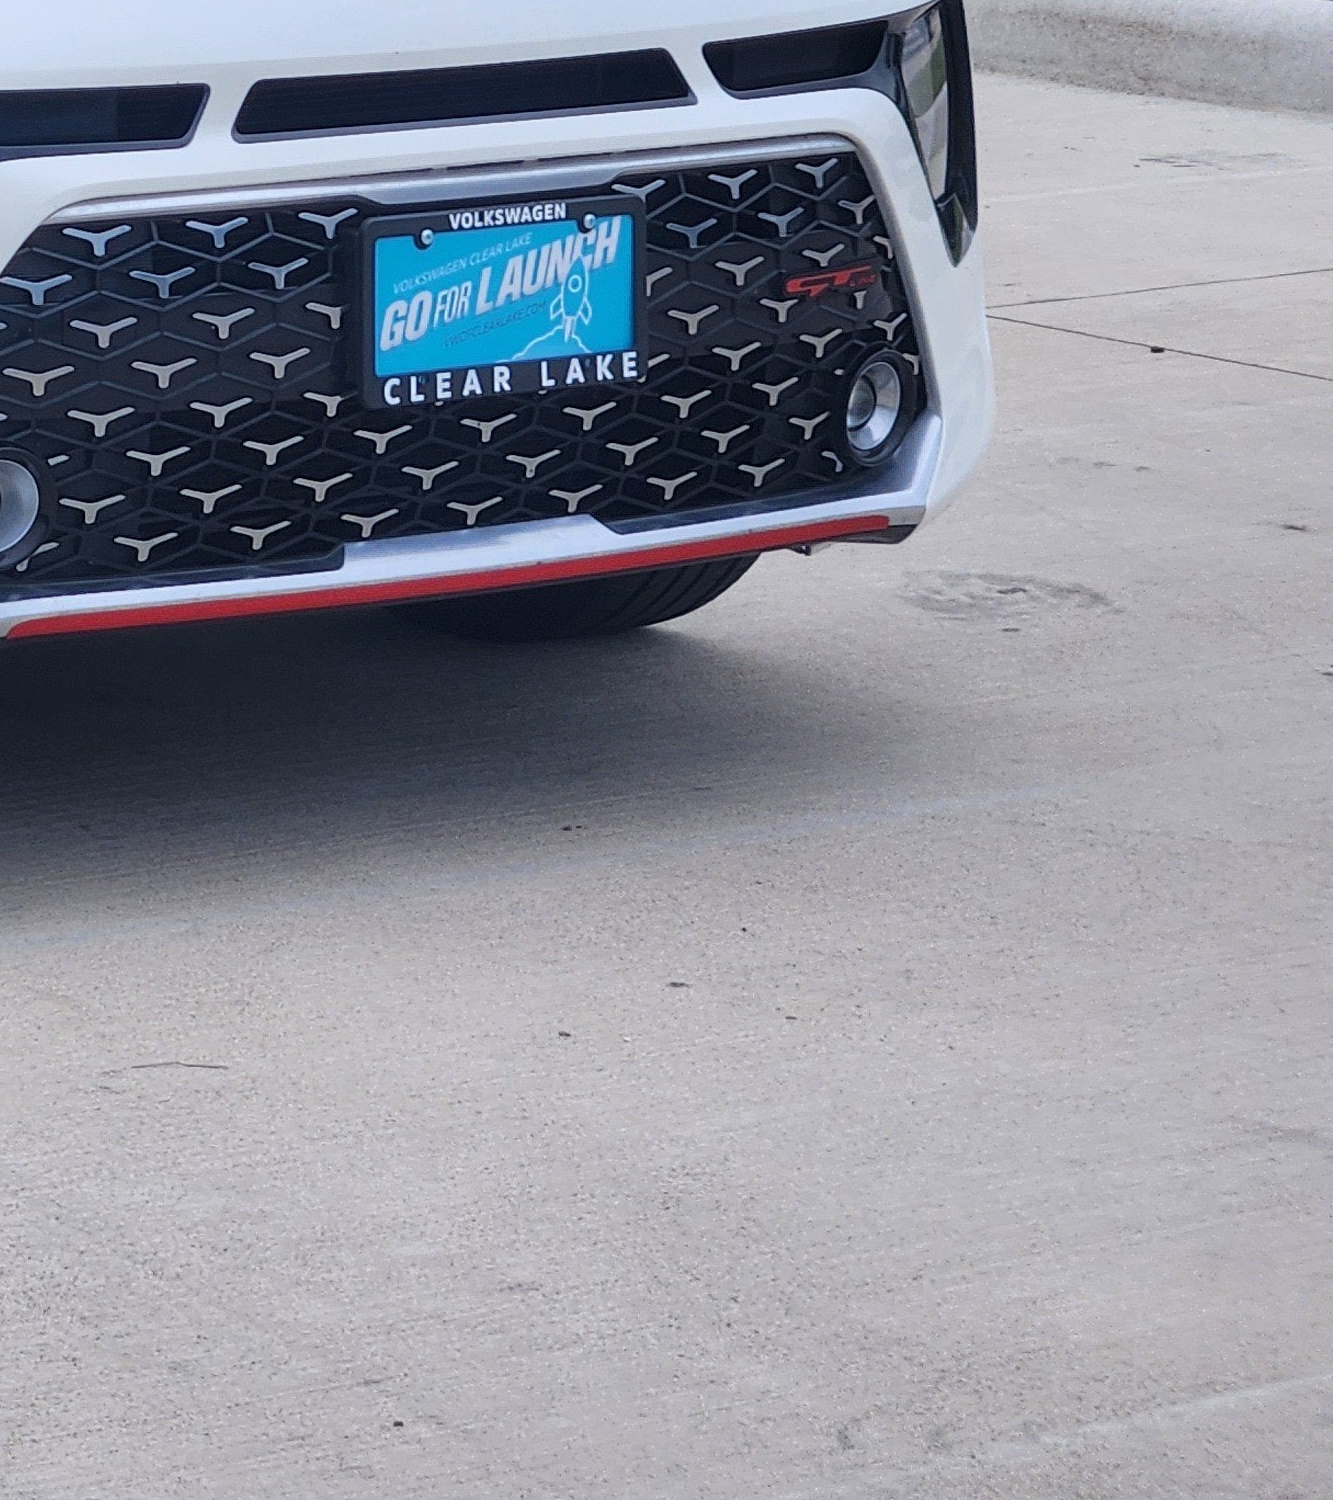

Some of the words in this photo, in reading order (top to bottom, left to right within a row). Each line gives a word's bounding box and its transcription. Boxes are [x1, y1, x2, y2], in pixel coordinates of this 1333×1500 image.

[449, 203, 566, 230] VOLKSWAGEN
[380, 290, 433, 351] GO
[433, 281, 472, 328] FOR
[475, 215, 622, 315] LAUNCH
[393, 258, 467, 294] VOLKSWAGEN
[469, 243, 503, 266] CLEAR
[505, 232, 533, 252] LAKE
[383, 365, 511, 405] CLEAR
[540, 351, 638, 387] LAKE
